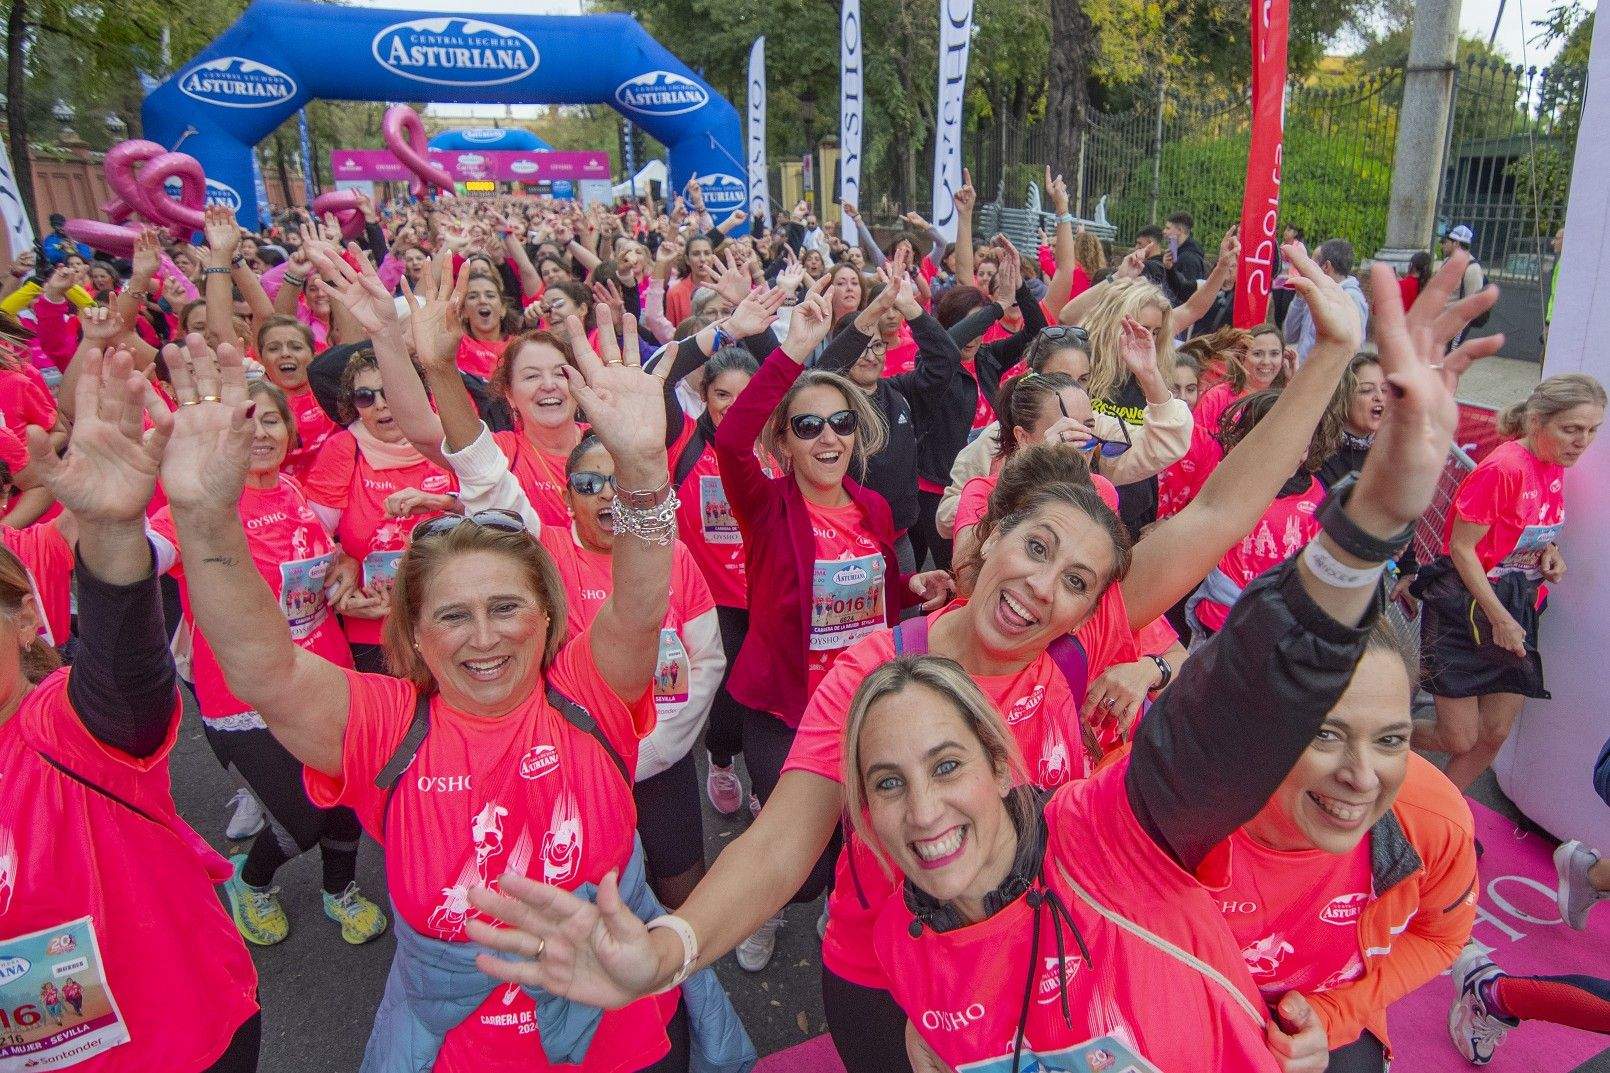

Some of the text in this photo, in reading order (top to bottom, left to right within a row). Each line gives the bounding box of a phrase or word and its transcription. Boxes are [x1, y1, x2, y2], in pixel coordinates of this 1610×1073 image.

[410, 35, 521, 47] CENTRAL LECHERA
[387, 35, 529, 69] ASTURIANA
[187, 73, 288, 97] ASTURIANA
[625, 88, 705, 106] ASTURIANA
[247, 511, 287, 529] OYSHO
[834, 597, 865, 614] 016
[480, 1010, 533, 1026] CARRERA DE
[922, 1002, 986, 1032] OYSHO
[11, 1041, 43, 1054] MUJER
[51, 1024, 91, 1044] SEVILLA
[40, 1037, 103, 1064] Santander
